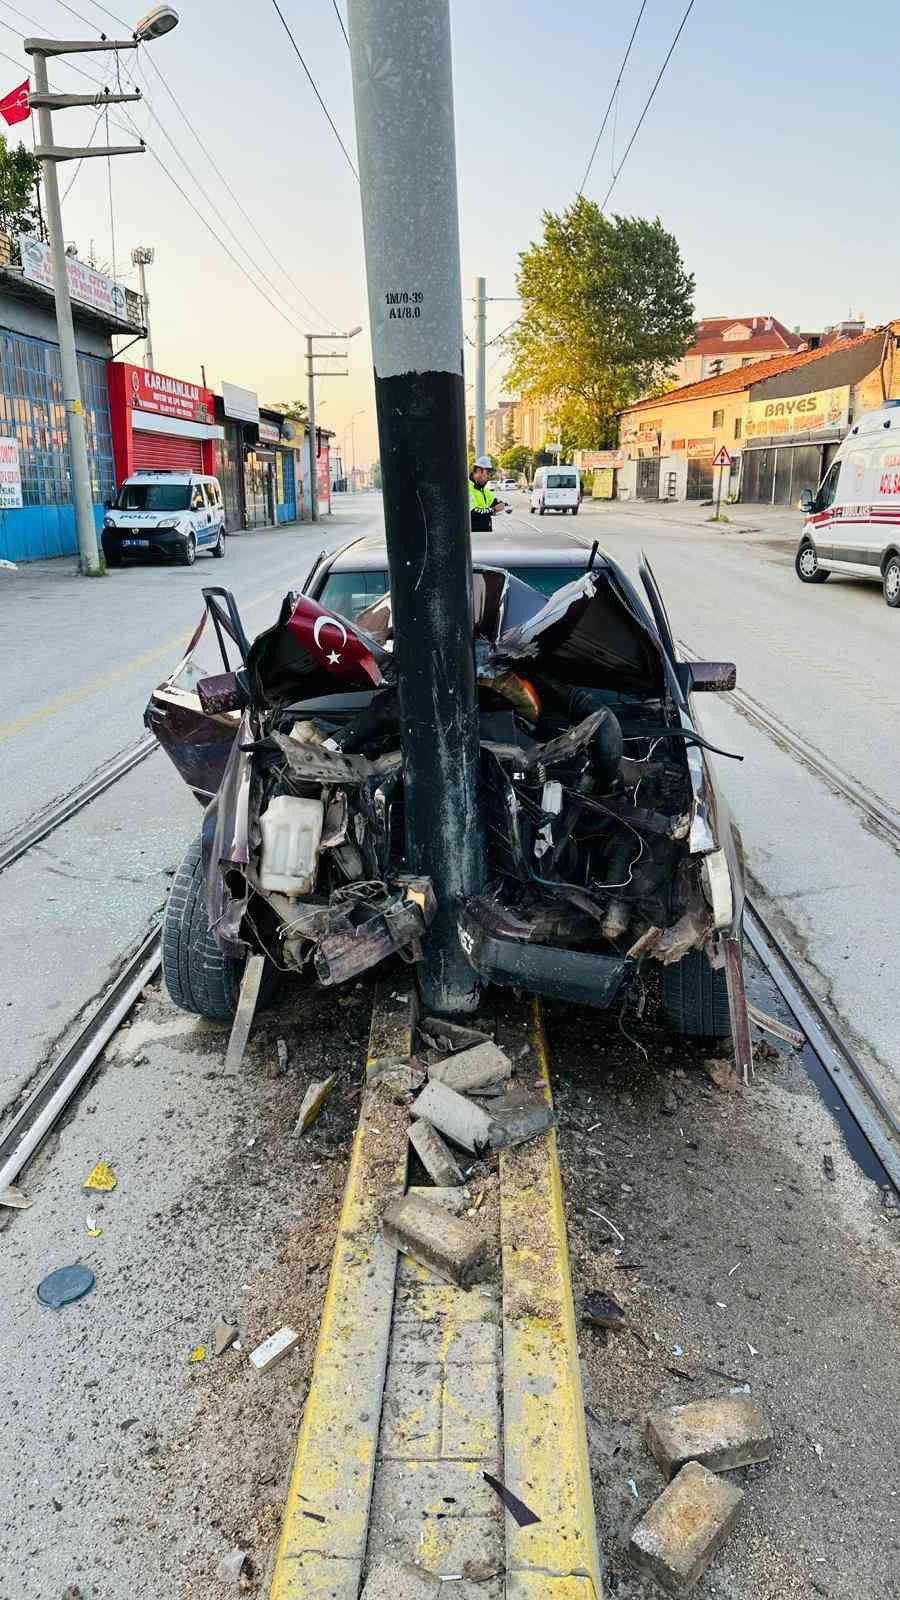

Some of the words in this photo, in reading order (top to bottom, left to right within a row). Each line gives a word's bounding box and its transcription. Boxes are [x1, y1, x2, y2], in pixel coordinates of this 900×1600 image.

[389, 307, 421, 319] A1/8.0
[144, 371, 199, 400] KARAMANLILAR
[765, 397, 817, 417] BAYES
